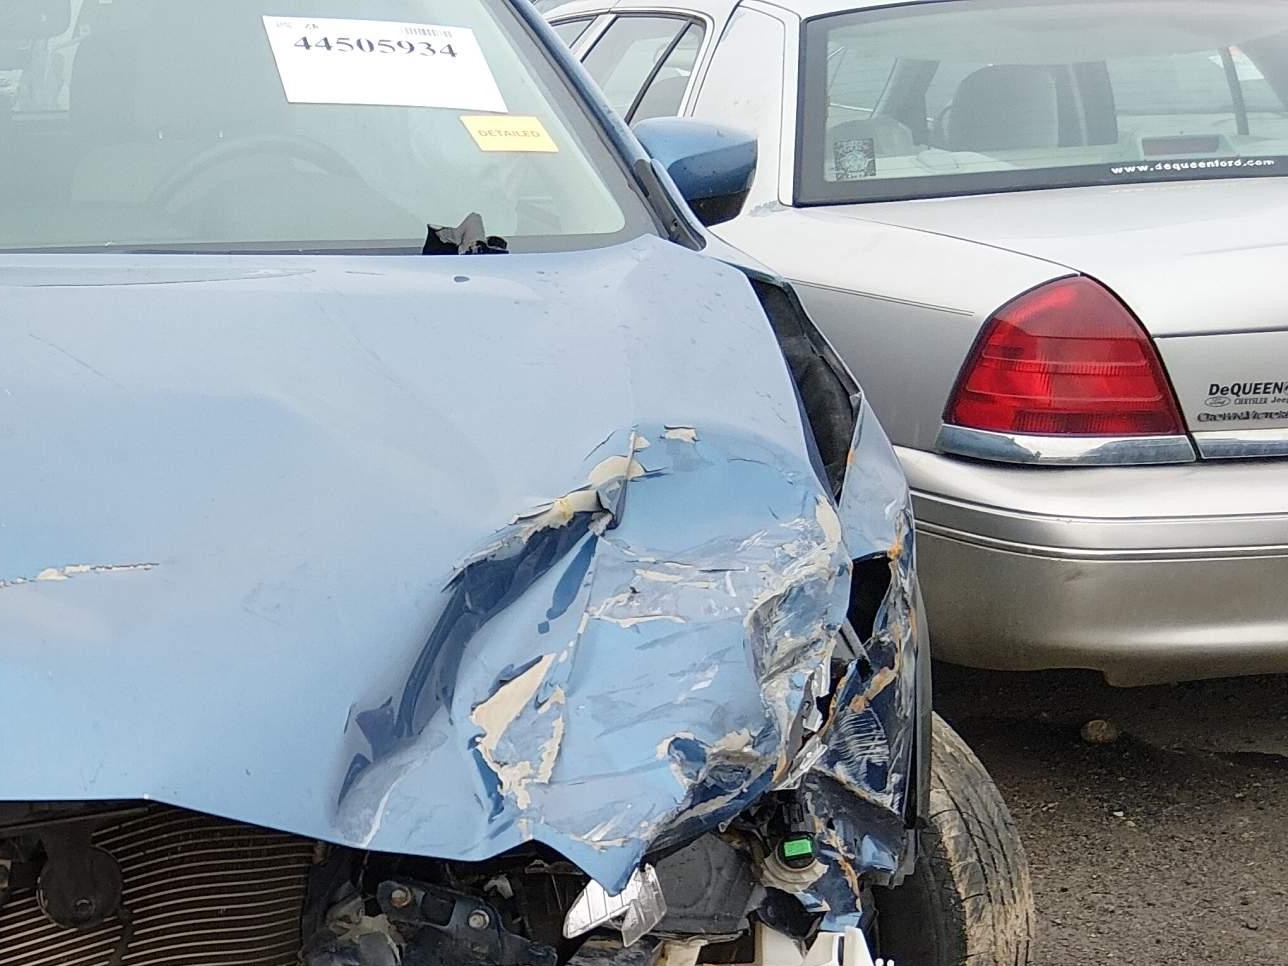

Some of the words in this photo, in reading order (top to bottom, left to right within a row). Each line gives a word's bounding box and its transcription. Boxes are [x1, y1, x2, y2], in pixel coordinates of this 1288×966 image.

[294, 36, 458, 57] 44505934
[1111, 159, 1274, 174] www.dequeenford.com
[1208, 382, 1284, 397] DeQUEEN
